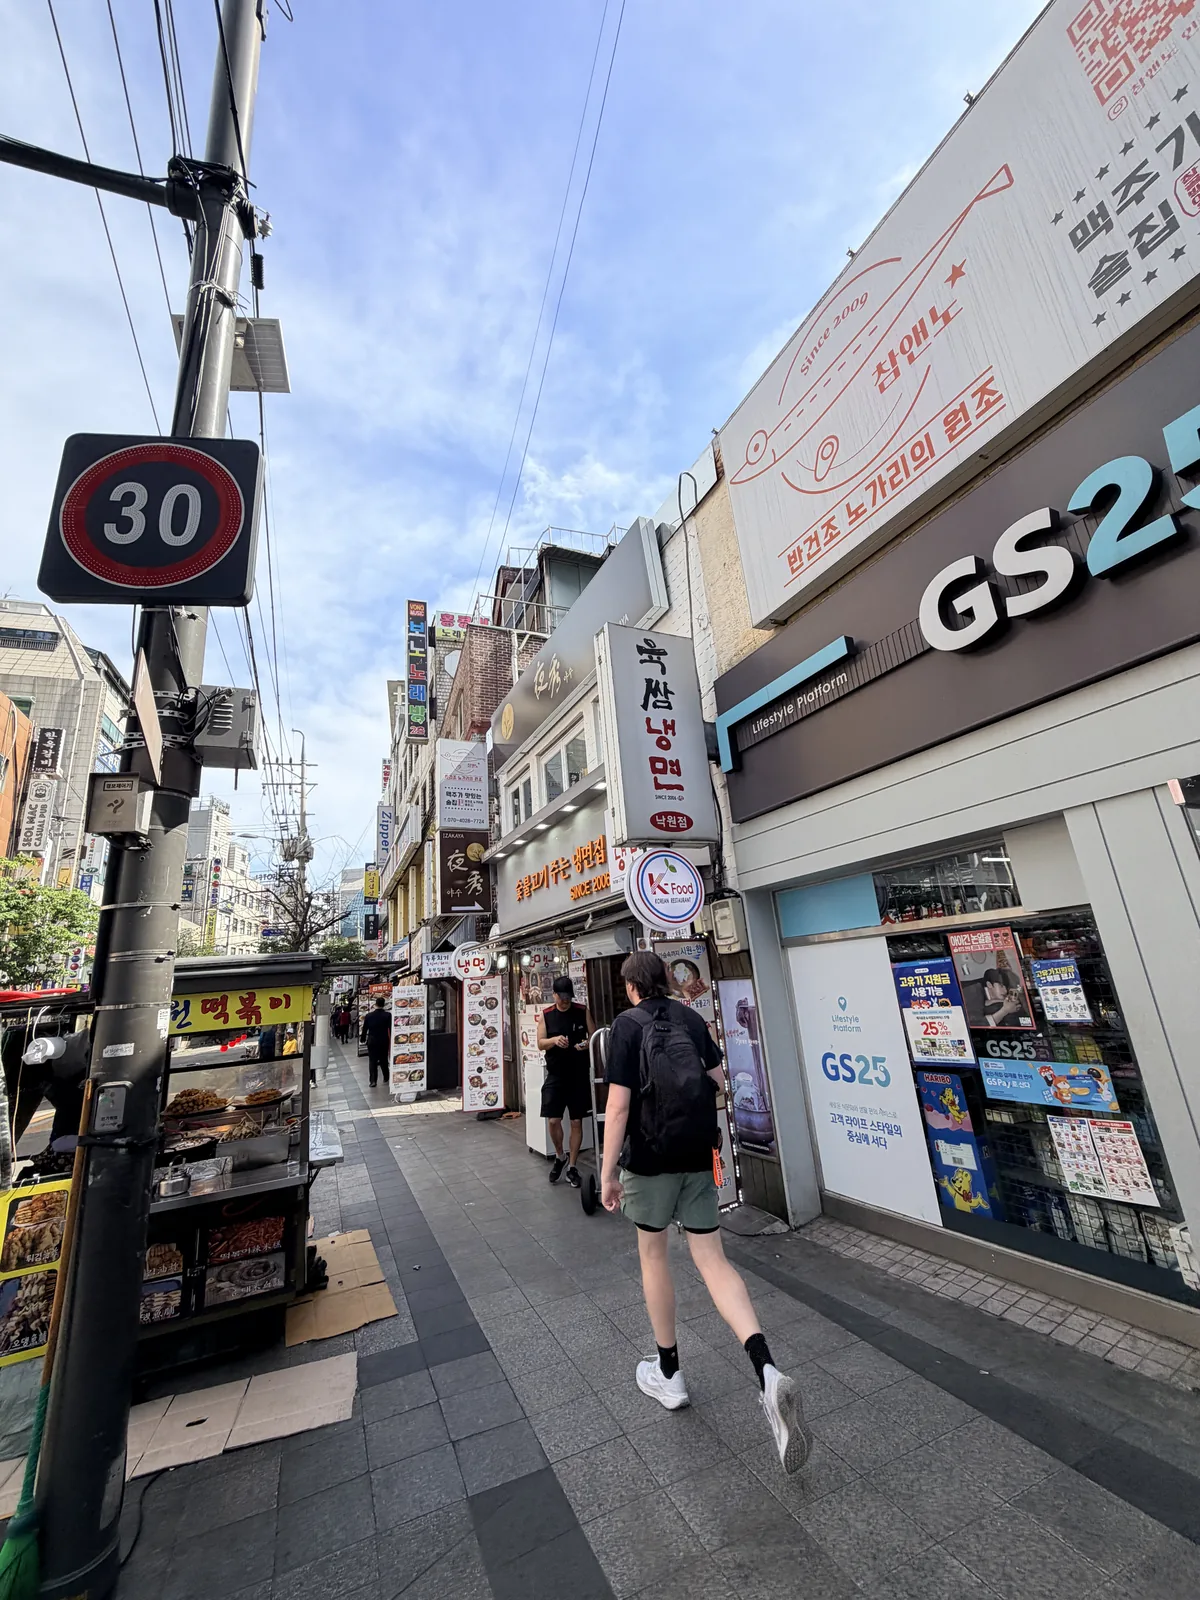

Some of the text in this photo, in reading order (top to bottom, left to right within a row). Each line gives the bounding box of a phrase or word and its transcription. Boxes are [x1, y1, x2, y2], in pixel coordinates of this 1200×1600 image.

[1088, 198, 1181, 299] 술집
[800, 291, 869, 376] Since 2009
[872, 299, 963, 395] 참앤노
[785, 375, 1005, 576] 반건조 노가리의 원조
[104, 482, 202, 546] 30
[752, 670, 848, 735] Lifestyle Platform
[446, 791, 463, 799] 맥주가
[39, 803, 48, 819] PUB
[655, 813, 688, 829] 낙원점
[22, 803, 39, 848] SEOL MAC
[34, 818, 45, 847] CASUAL
[379, 811, 392, 854] Zipper
[515, 834, 607, 902] 숯불고기 주는 냉면집
[447, 888, 462, 898] 야수
[569, 879, 592, 901] SINCE
[592, 871, 610, 893] 2006
[457, 958, 486, 973] 냉면
[899, 972, 951, 988] 고유가 지원금
[911, 987, 944, 998] 사용가능
[201, 991, 291, 1026] 떡볶이
[832, 1015, 860, 1024] Lifestyle
[833, 1024, 862, 1032] Platform
[920, 1021, 948, 1036] 25%
[986, 1039, 1037, 1059] GS25
[821, 1052, 891, 1088] GS25
[923, 1073, 951, 1084] HARIBO
[830, 1113, 903, 1138] 고객 라이프 스타일의
[847, 1130, 888, 1150] 중심에 서다
